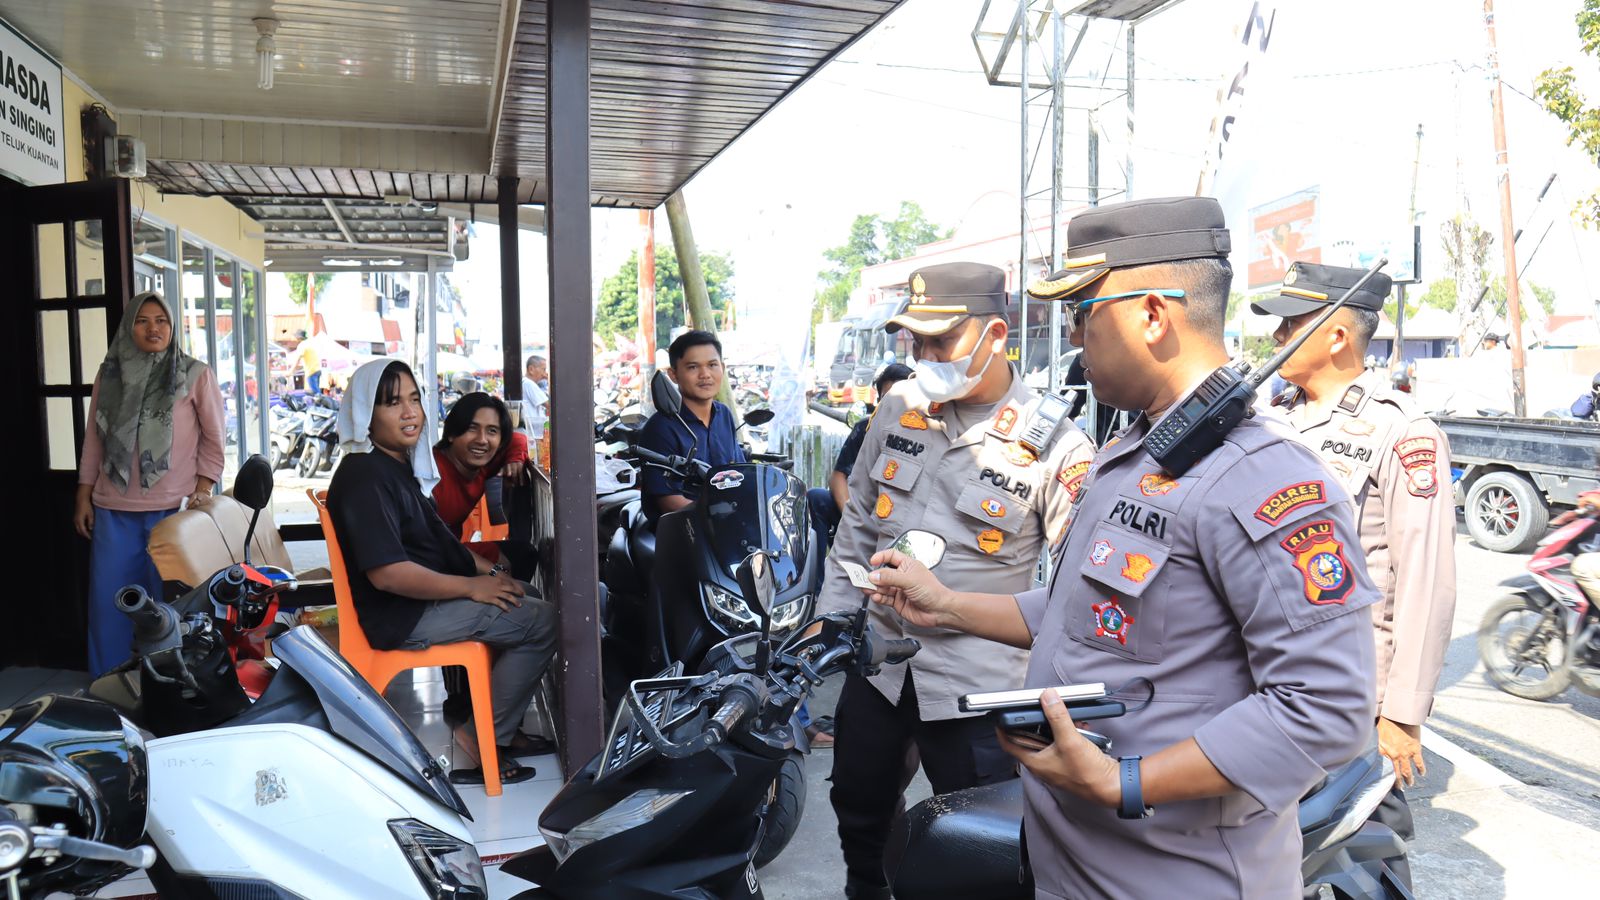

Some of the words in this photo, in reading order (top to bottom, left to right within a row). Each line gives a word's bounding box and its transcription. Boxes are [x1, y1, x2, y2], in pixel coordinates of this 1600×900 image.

[9, 105, 56, 147] SINGINGI
[1, 131, 26, 154] TELUK
[27, 145, 59, 170] KUANTAN
[1320, 439, 1373, 462] POLRI
[980, 467, 1032, 500] POLRI
[1262, 484, 1319, 515] POLRES
[1109, 499, 1167, 539] POLRI
[1289, 524, 1329, 546] RIAU
